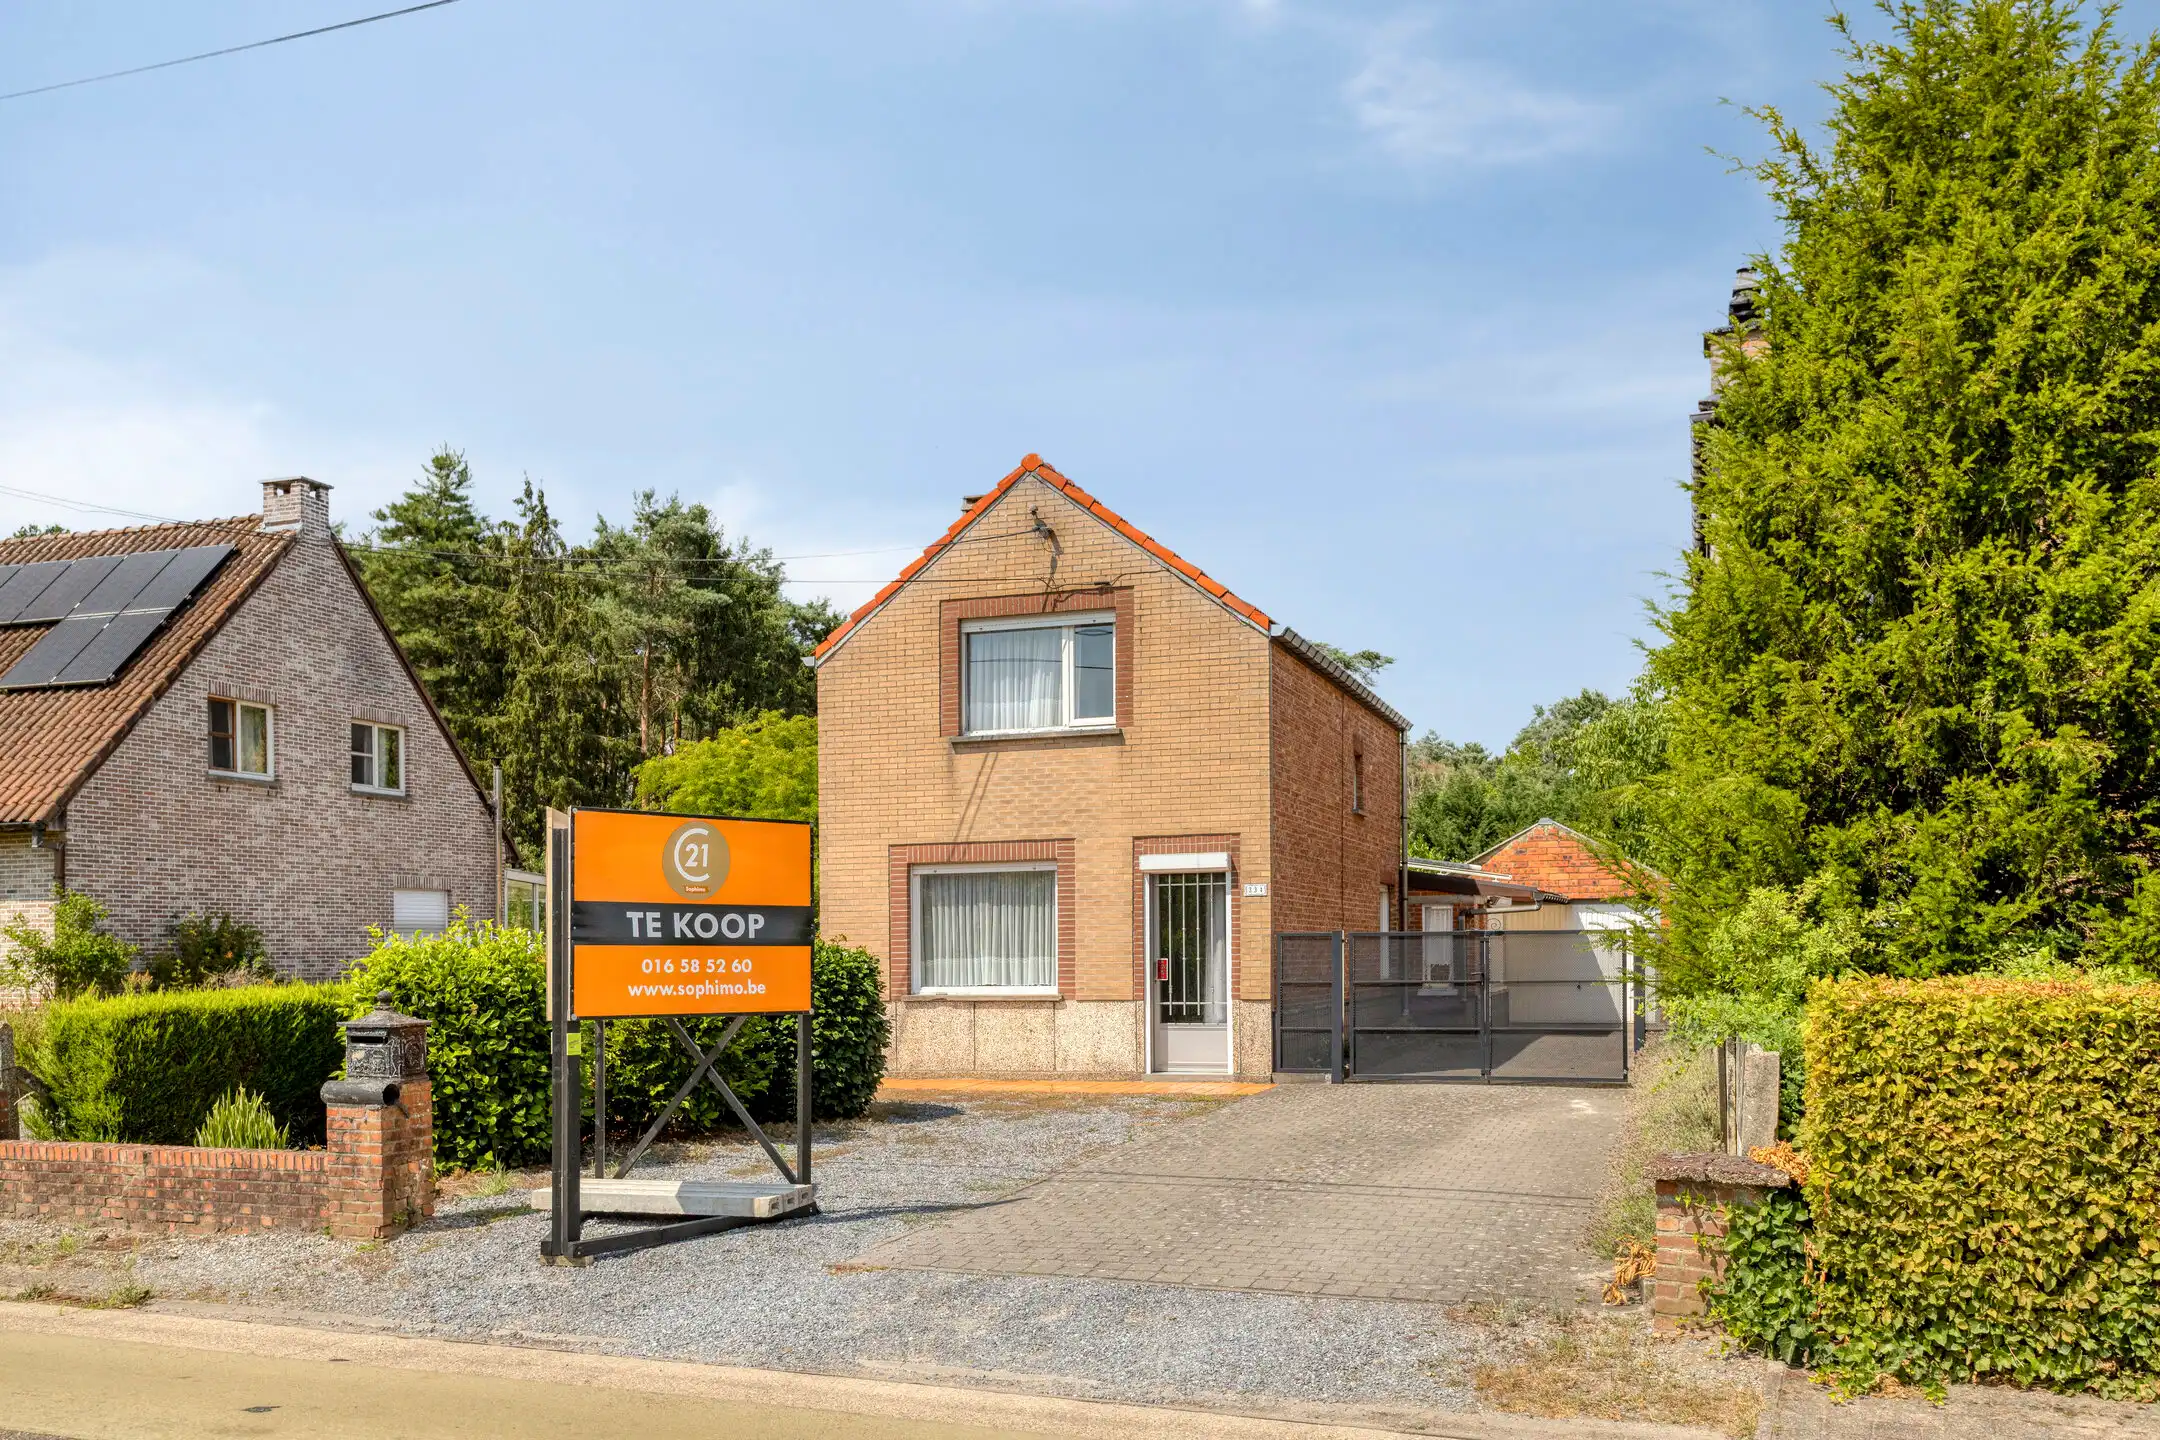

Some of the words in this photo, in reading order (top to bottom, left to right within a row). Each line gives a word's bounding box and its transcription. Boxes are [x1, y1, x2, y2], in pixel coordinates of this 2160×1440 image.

[626, 911, 662, 938] TE
[673, 912, 765, 939] KOOP
[641, 959, 674, 973] 016
[680, 959, 700, 973] 58
[706, 959, 726, 973] 52
[731, 959, 752, 973] 60
[628, 979, 766, 999] www.sophimo.be
